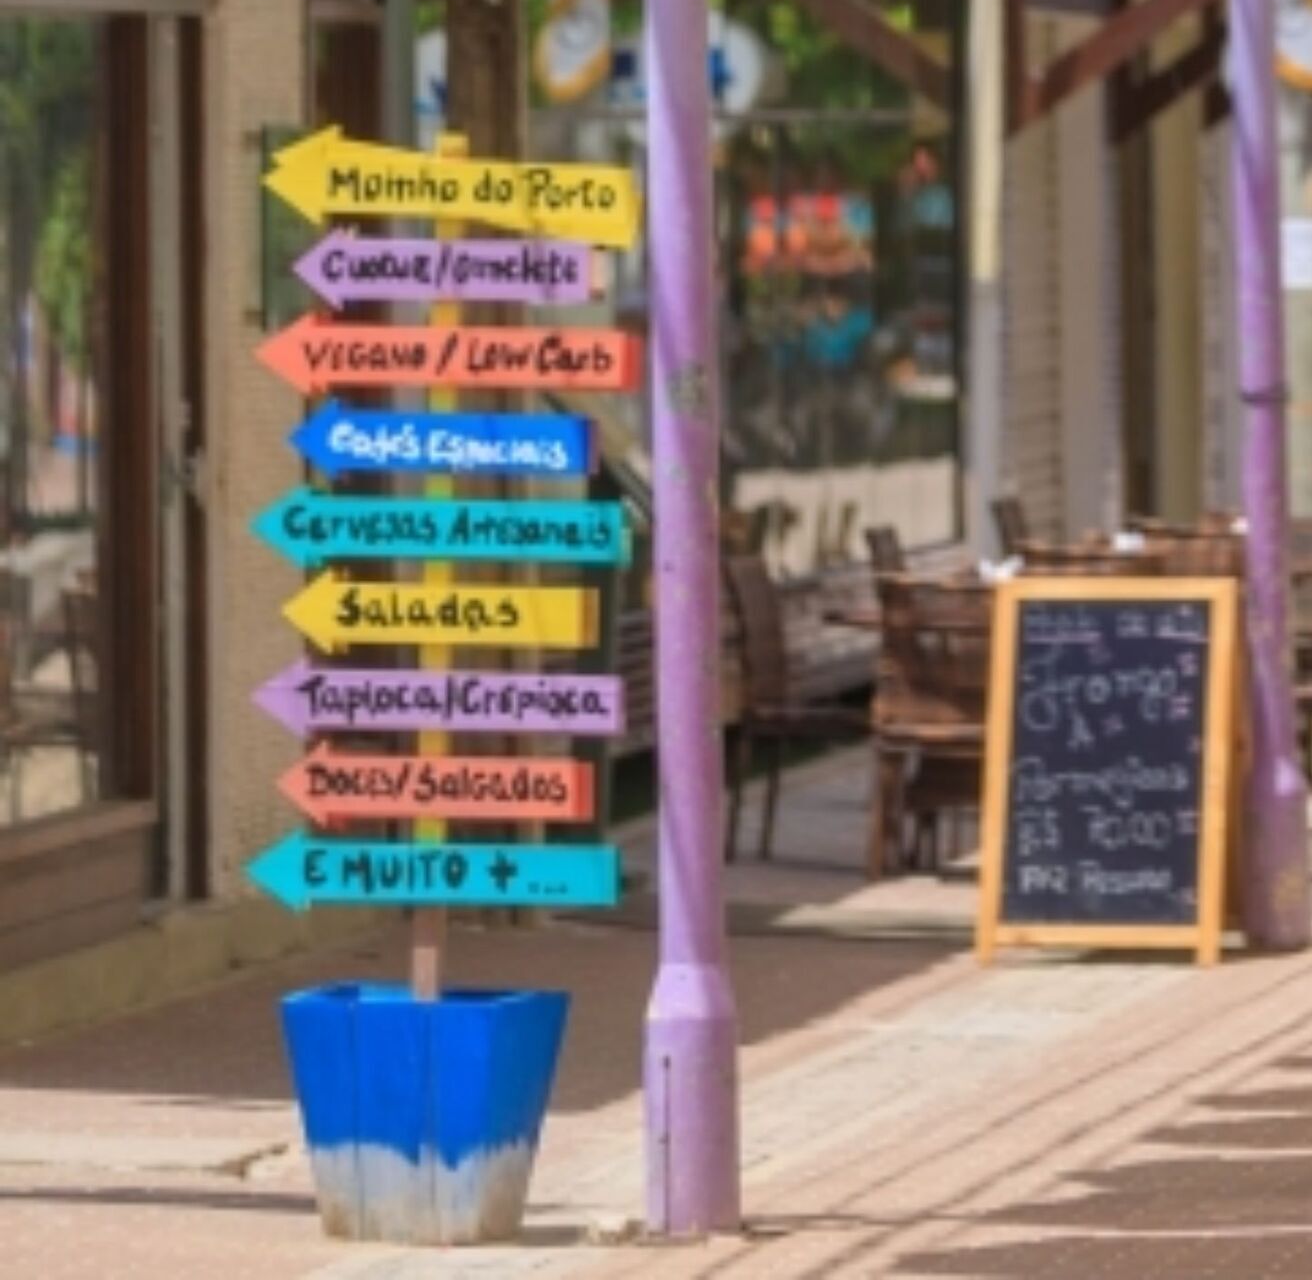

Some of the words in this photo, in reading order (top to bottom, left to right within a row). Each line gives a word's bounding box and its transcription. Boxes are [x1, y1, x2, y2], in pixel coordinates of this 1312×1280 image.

[334, 587, 520, 631] Saladas
[304, 849, 328, 886] E
[343, 849, 469, 893] MUITO
